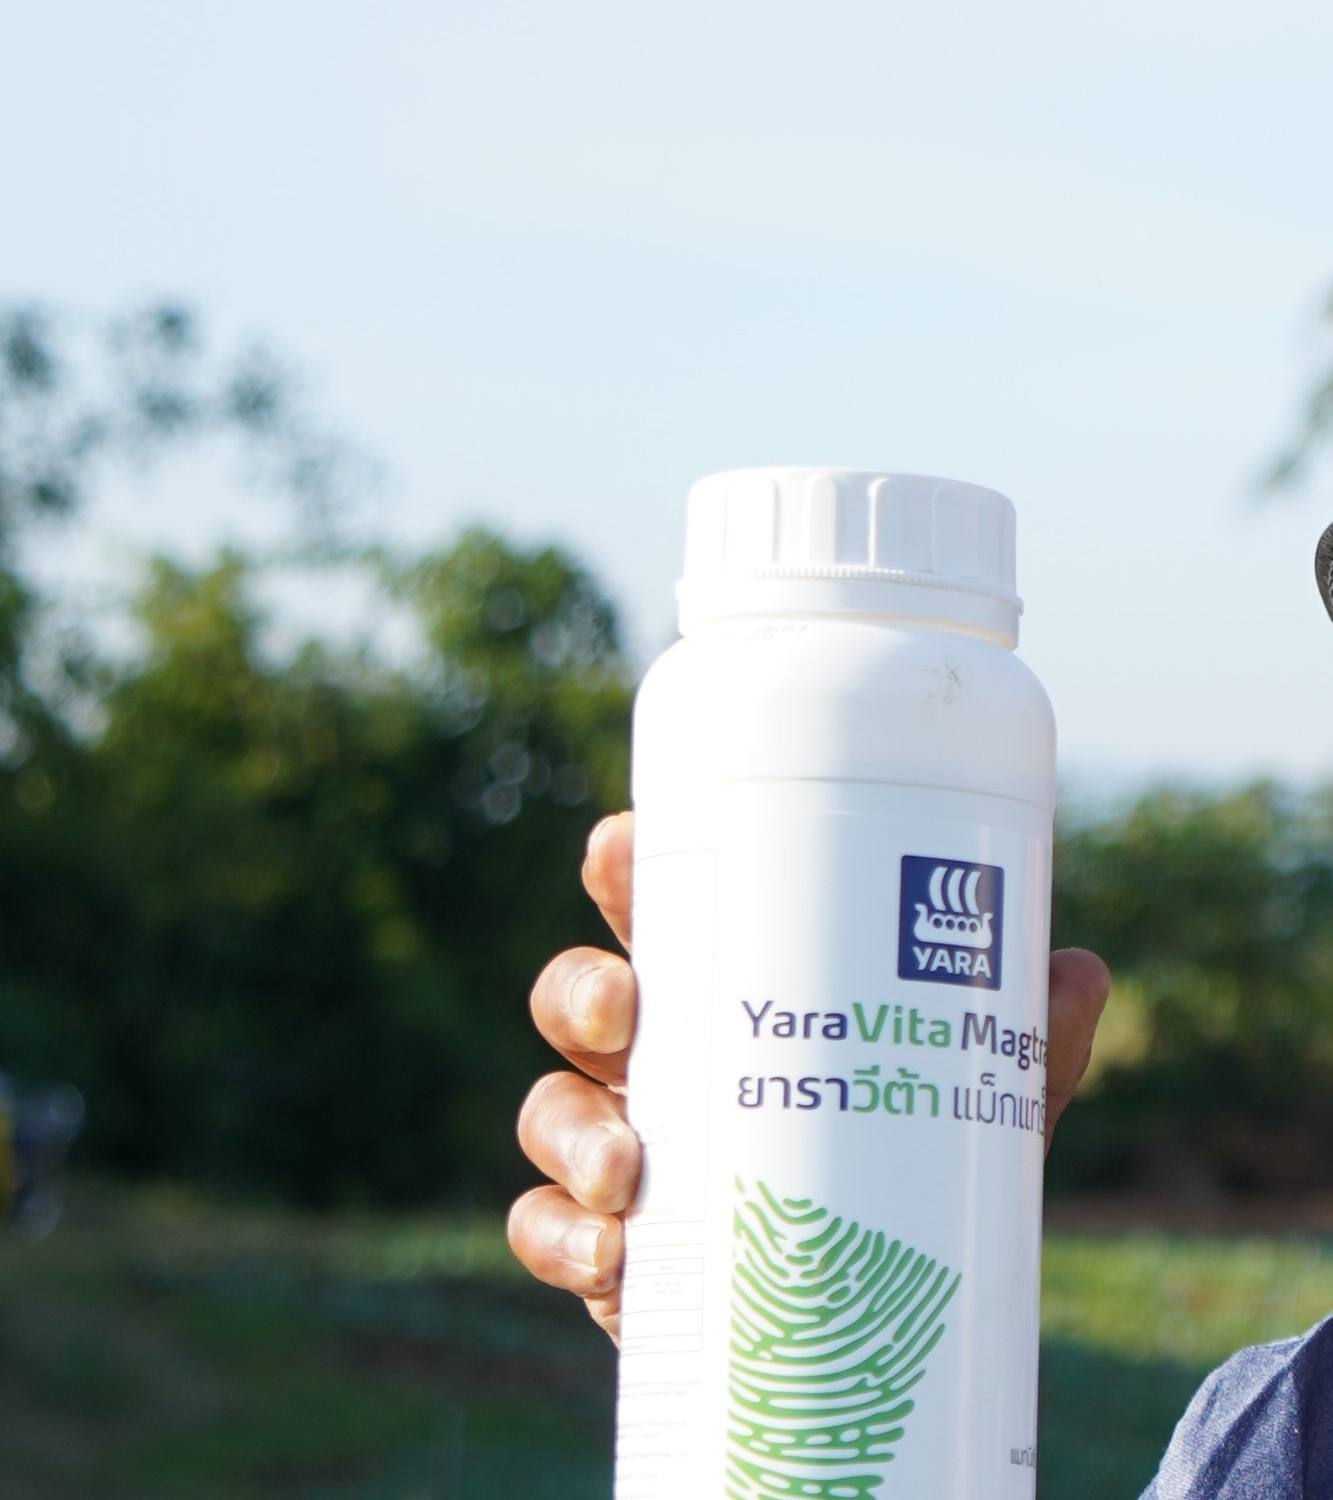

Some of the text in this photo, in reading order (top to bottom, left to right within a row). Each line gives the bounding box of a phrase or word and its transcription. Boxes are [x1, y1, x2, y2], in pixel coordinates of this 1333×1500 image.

[911, 945, 993, 979] YARA
[740, 1000, 952, 1049] YaraVita
[736, 1064, 941, 1119] ยาราวีต้า
